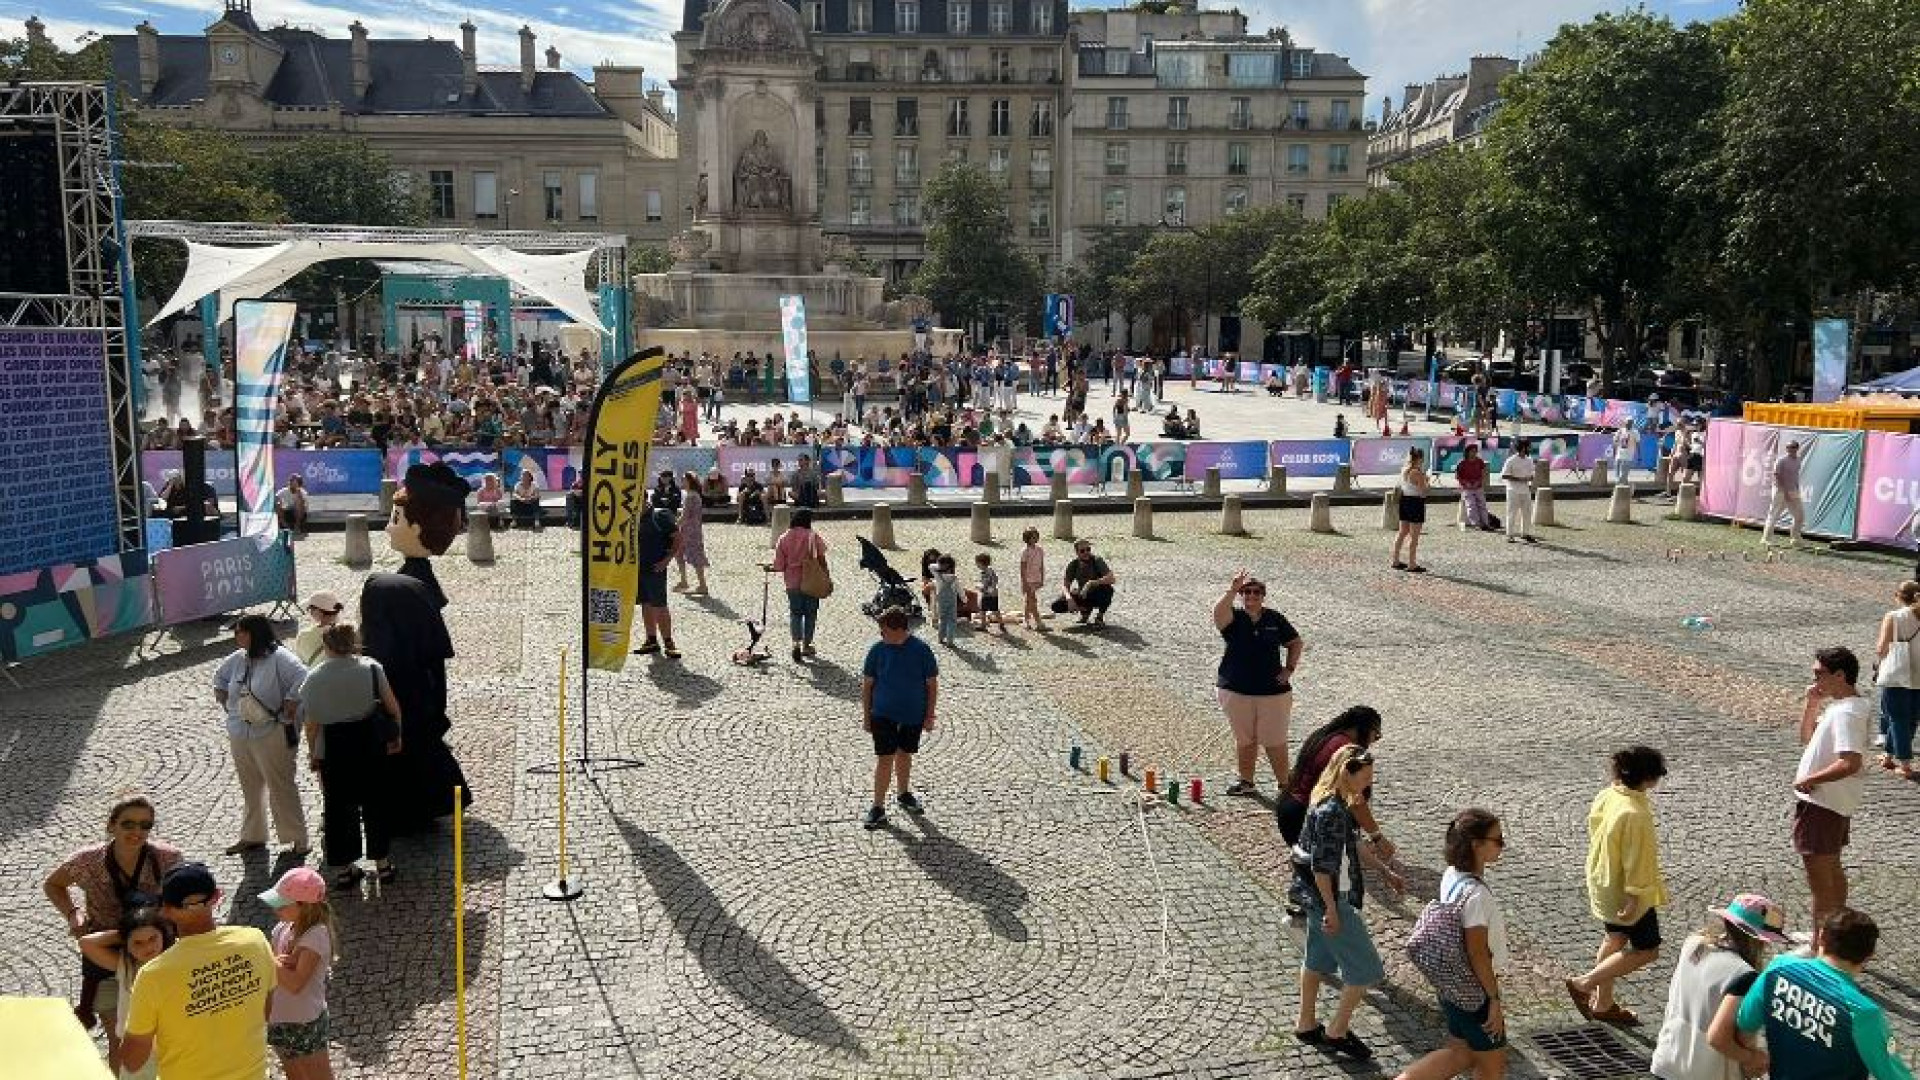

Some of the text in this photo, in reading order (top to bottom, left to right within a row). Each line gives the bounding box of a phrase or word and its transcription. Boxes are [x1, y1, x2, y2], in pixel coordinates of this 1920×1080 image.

[4, 359, 41, 371] GAMES
[592, 436, 618, 563] HOLY
[614, 439, 639, 565] GAMES
[201, 554, 252, 579] PARIS
[203, 575, 255, 600] 2024
[187, 960, 253, 989] VICTOIRE
[191, 953, 243, 978] PAR TA
[1773, 974, 1838, 1027] PARIS
[1771, 999, 1834, 1048] 2024
